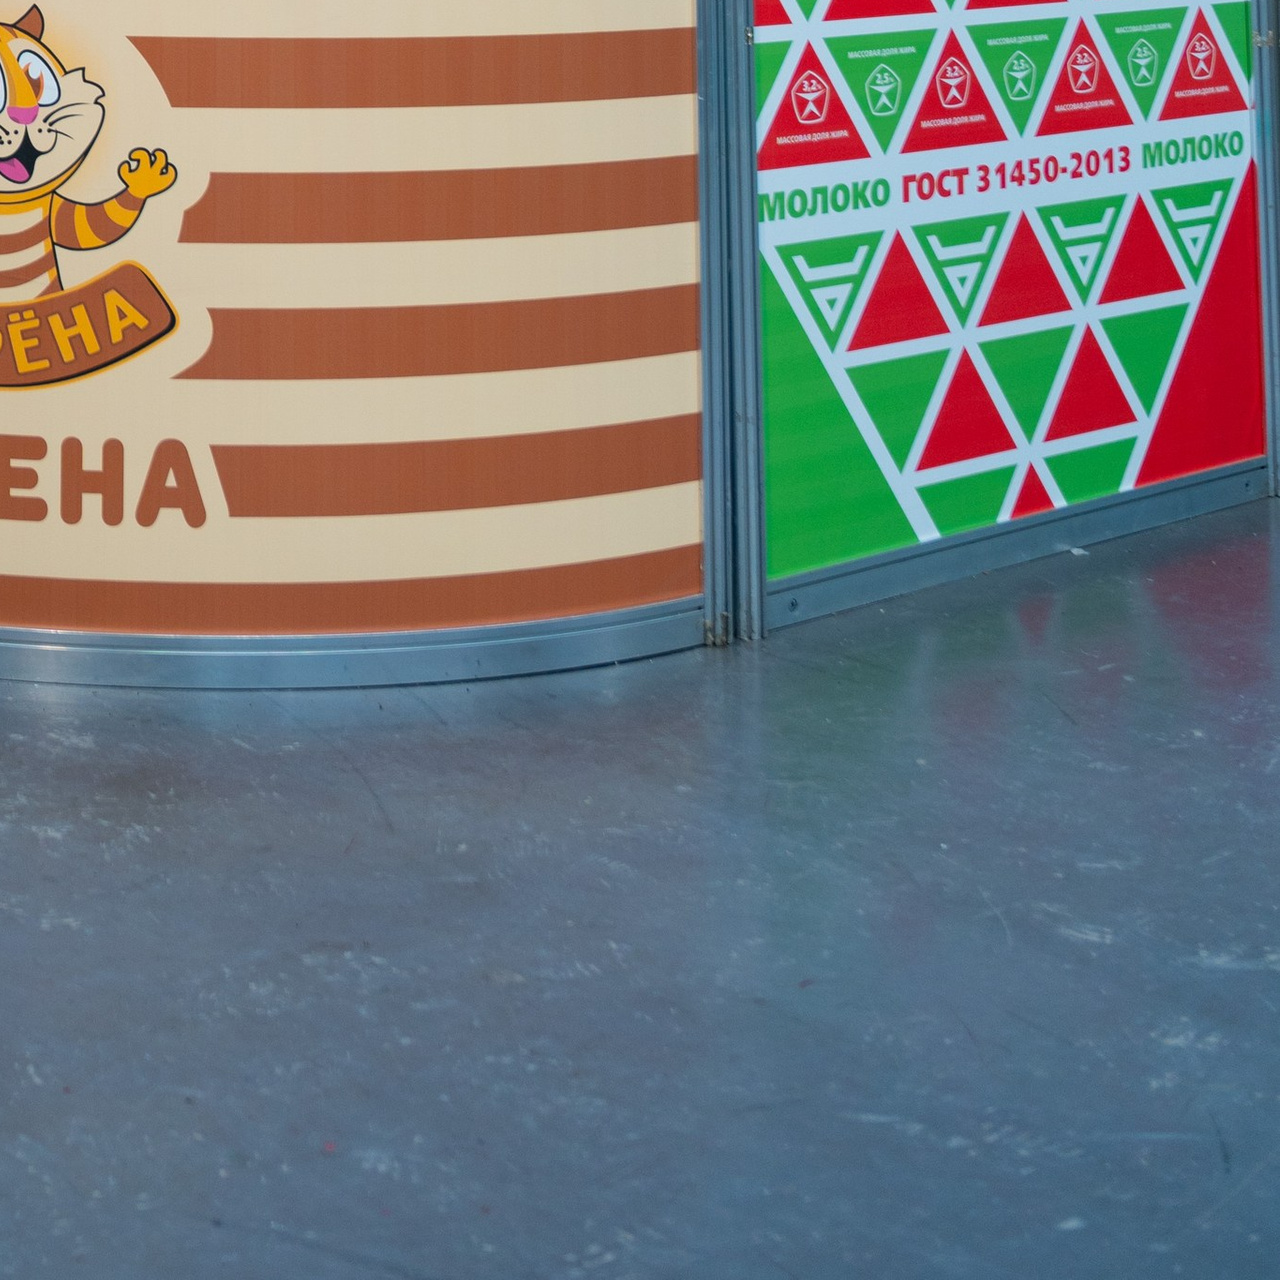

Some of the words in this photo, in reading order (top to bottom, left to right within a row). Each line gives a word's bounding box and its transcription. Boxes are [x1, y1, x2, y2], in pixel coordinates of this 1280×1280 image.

[758, 177, 891, 223] МОЛОКО
[902, 167, 970, 204] ГОСТ
[976, 145, 1132, 193] 31450-2013
[1142, 130, 1244, 170] МОЛОКО
